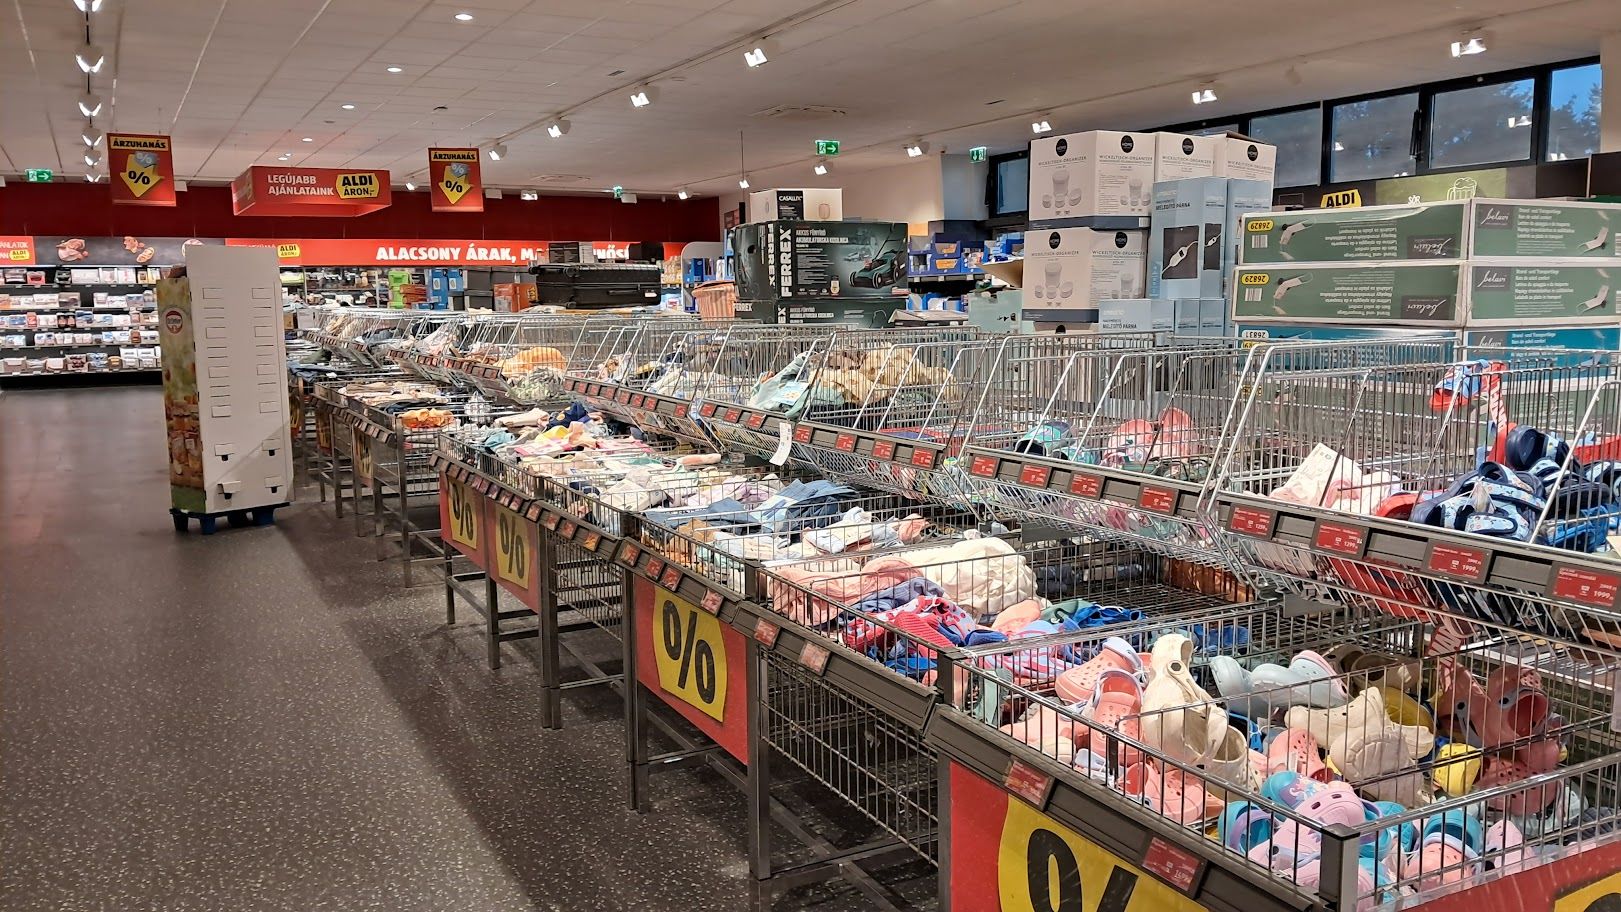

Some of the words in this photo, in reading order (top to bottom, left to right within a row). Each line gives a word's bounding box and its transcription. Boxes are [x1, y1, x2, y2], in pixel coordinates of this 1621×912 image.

[112, 138, 166, 148] ÁRZUHANÁS
[433, 152, 476, 160] ÁRZUHANÁS
[128, 170, 150, 184] %
[268, 172, 316, 184] LEGÚJABB
[342, 174, 373, 187] ALDI
[268, 184, 335, 196] AJÁNLATAINK
[445, 180, 463, 192] %
[1326, 192, 1355, 208] ALDI
[1480, 208, 1509, 225] belavi
[376, 247, 461, 260] ALACSONY
[466, 243, 516, 263] ÁRAK,
[768, 224, 776, 287] FERREX
[780, 228, 793, 298] FERREX
[1477, 270, 1506, 288] belavi
[1407, 299, 1446, 316] belavi
[452, 482, 474, 541] %
[500, 512, 525, 579] %
[662, 600, 716, 704] %
